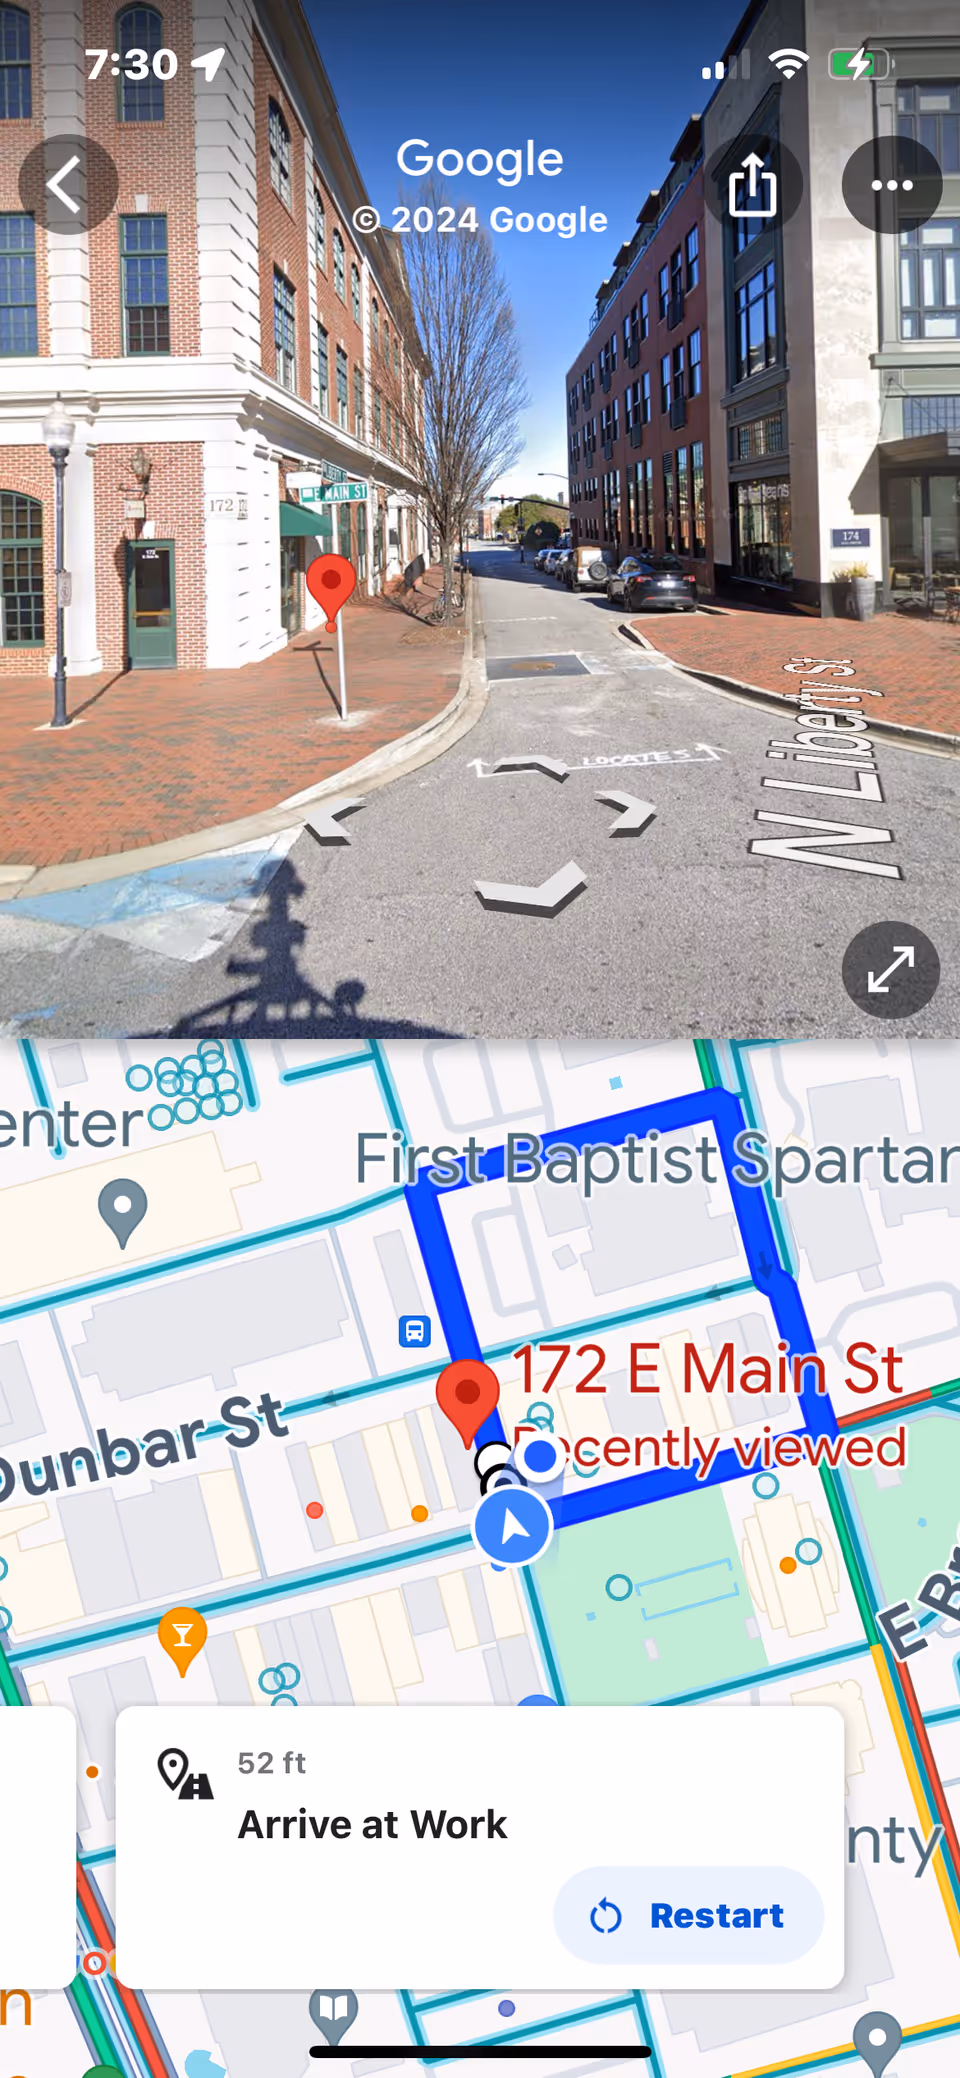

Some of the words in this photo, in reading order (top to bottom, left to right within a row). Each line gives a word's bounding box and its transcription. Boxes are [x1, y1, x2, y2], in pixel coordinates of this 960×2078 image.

[210, 499, 234, 512] 172
[314, 487, 320, 501] E
[324, 485, 349, 501] MAIN
[354, 483, 367, 499] ST
[842, 530, 860, 541] 174
[582, 749, 690, 766] LOCATES
[357, 1132, 485, 1184] First
[507, 1132, 717, 1197] Baptist
[513, 1343, 606, 1394] 172
[630, 1343, 660, 1393] E
[684, 1342, 825, 1394] Main
[845, 1342, 903, 1394] St
[220, 1392, 289, 1448] St
[514, 1426, 720, 1478] cently
[734, 1426, 905, 1467] viewed
[878, 1601, 928, 1660] E
[238, 1751, 274, 1774] 52
[283, 1750, 306, 1774] ft
[238, 1807, 352, 1839] Arrive
[362, 1810, 398, 1839] at
[410, 1808, 508, 1839] Work
[848, 1817, 943, 1878] nty
[651, 1903, 784, 1929] Restart
